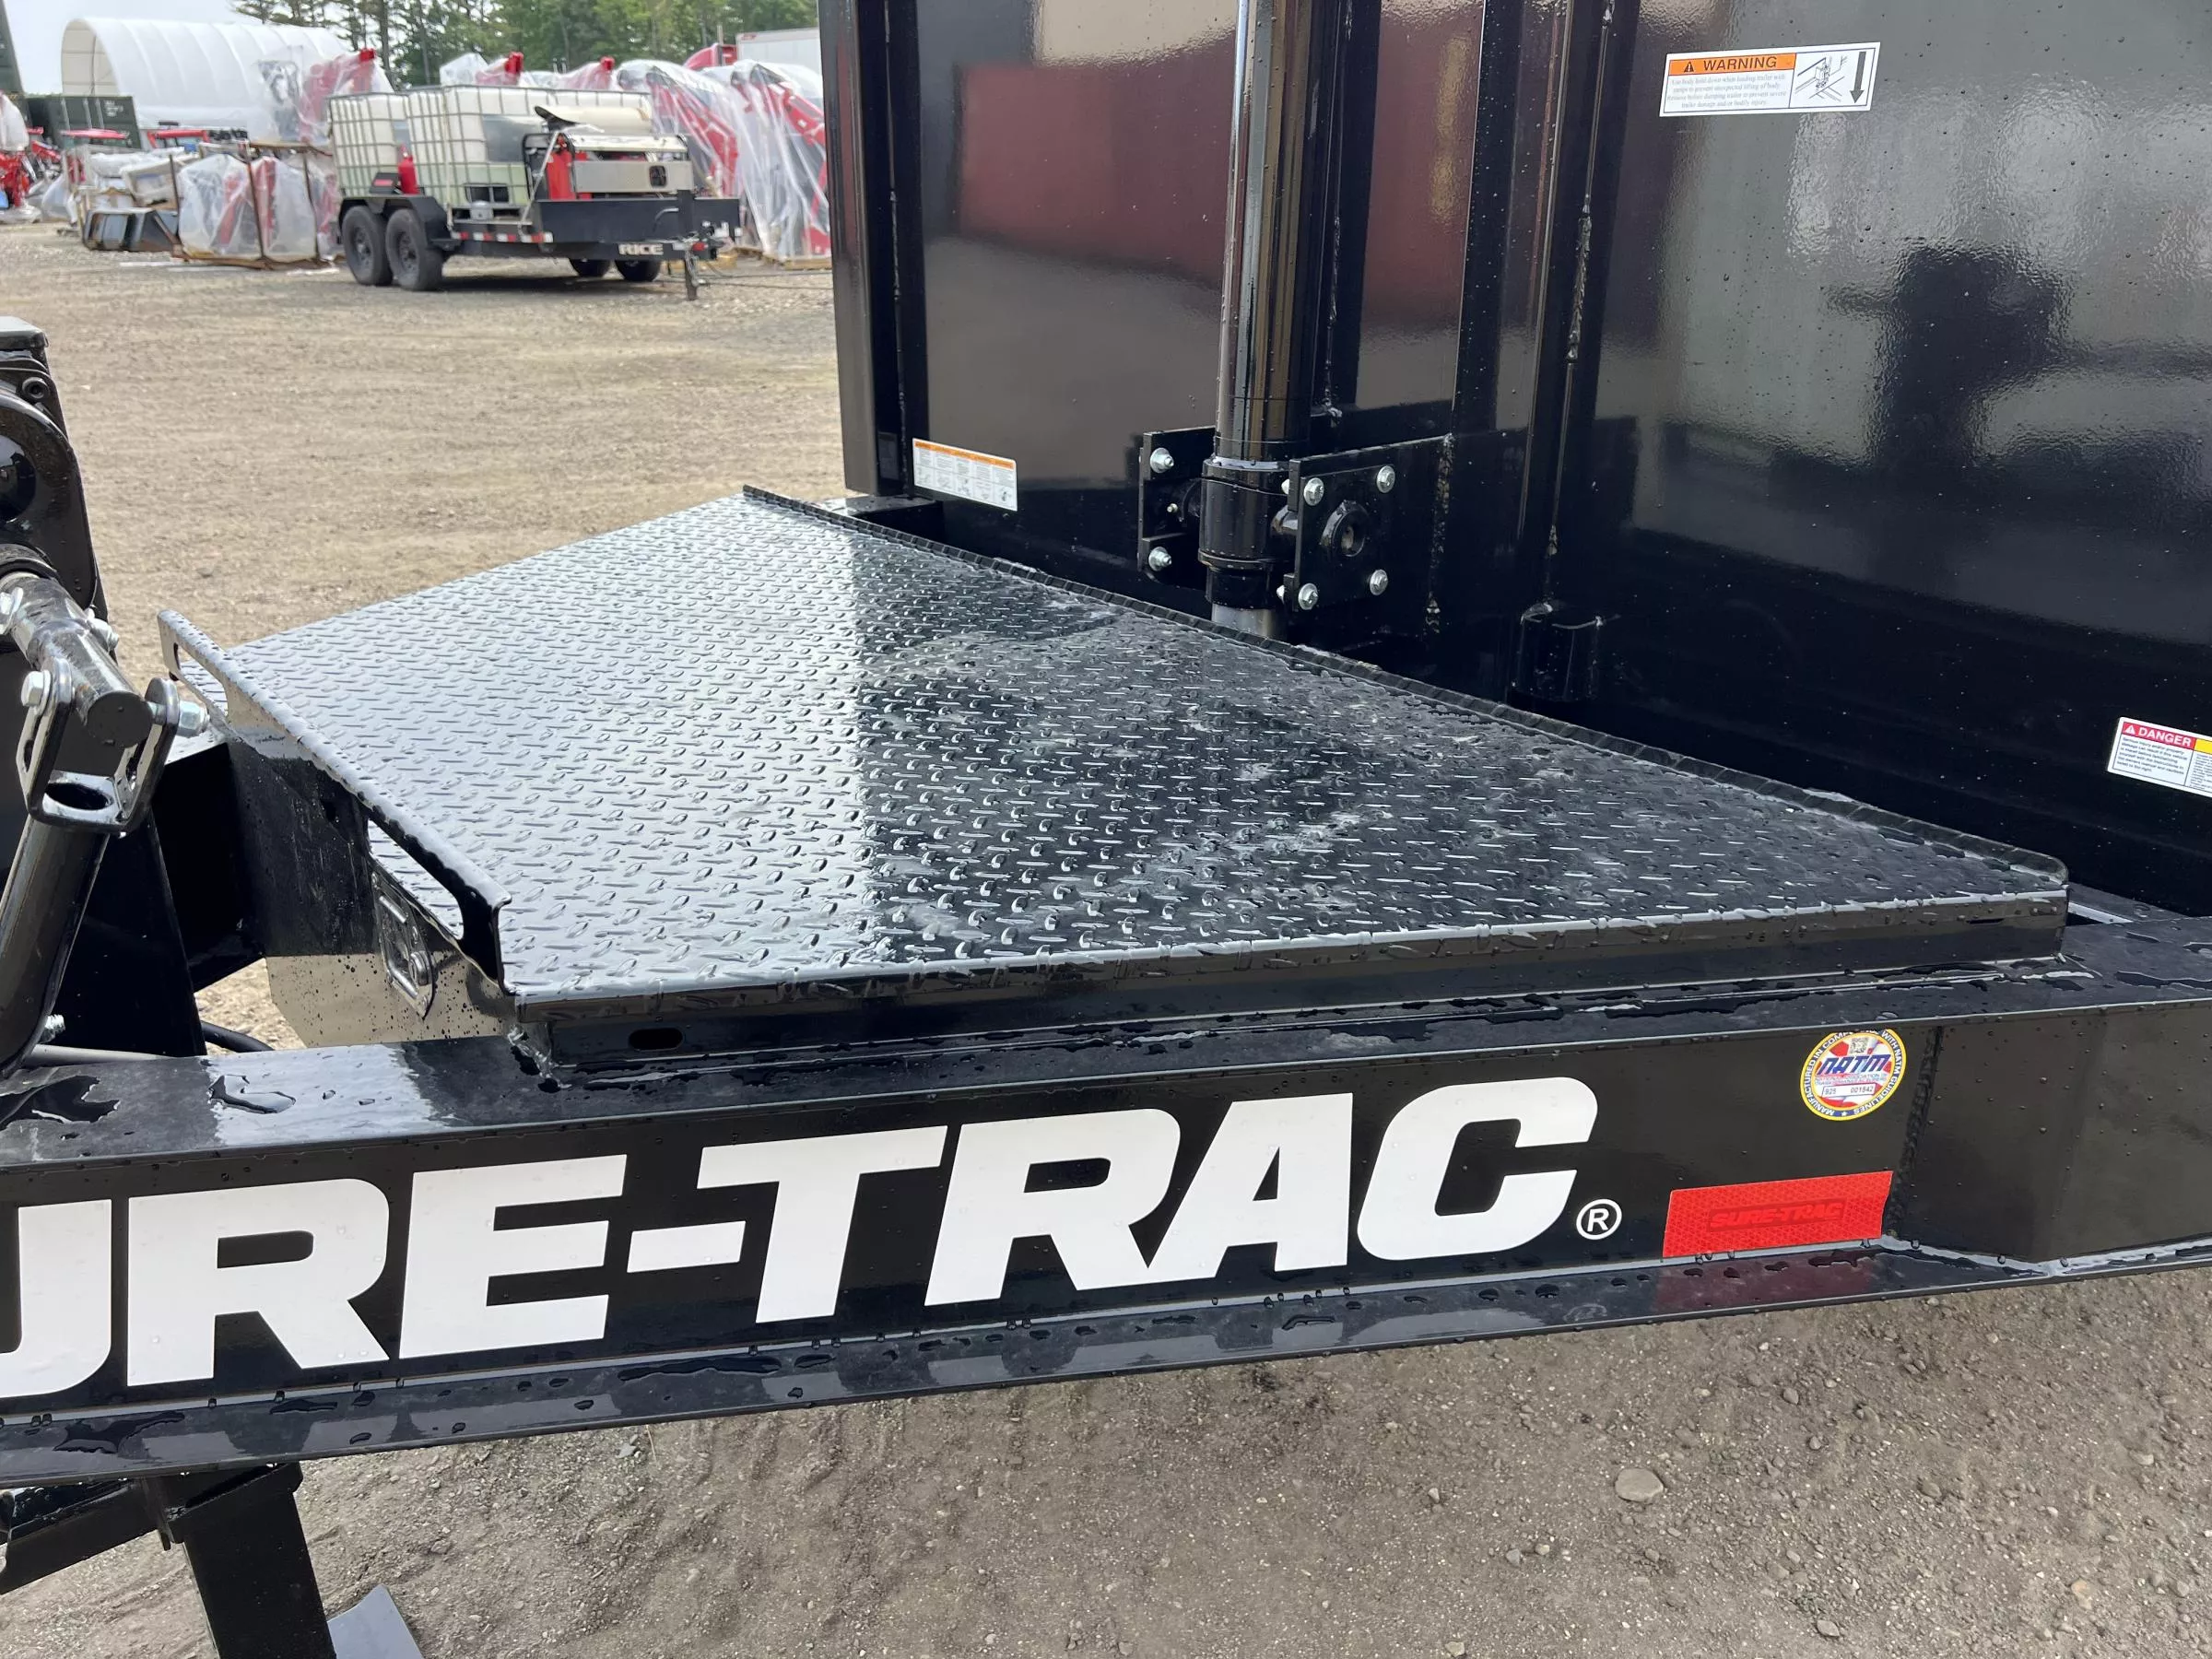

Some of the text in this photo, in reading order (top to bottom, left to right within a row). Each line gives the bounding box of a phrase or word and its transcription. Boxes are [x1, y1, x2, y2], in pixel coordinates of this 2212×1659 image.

[1703, 56, 1777, 71] WARNING
[618, 243, 664, 255] RICE
[2138, 727, 2191, 747] DANGER
[1881, 1030, 1899, 1050] WITH
[1816, 1053, 1891, 1076] NATM
[1893, 1049, 1903, 1075] NATM
[1804, 1059, 1835, 1116] MANUFACTURED
[1853, 1074, 1899, 1115] GUIDELINES
[1710, 1202, 1844, 1228] SURE-TRAC
